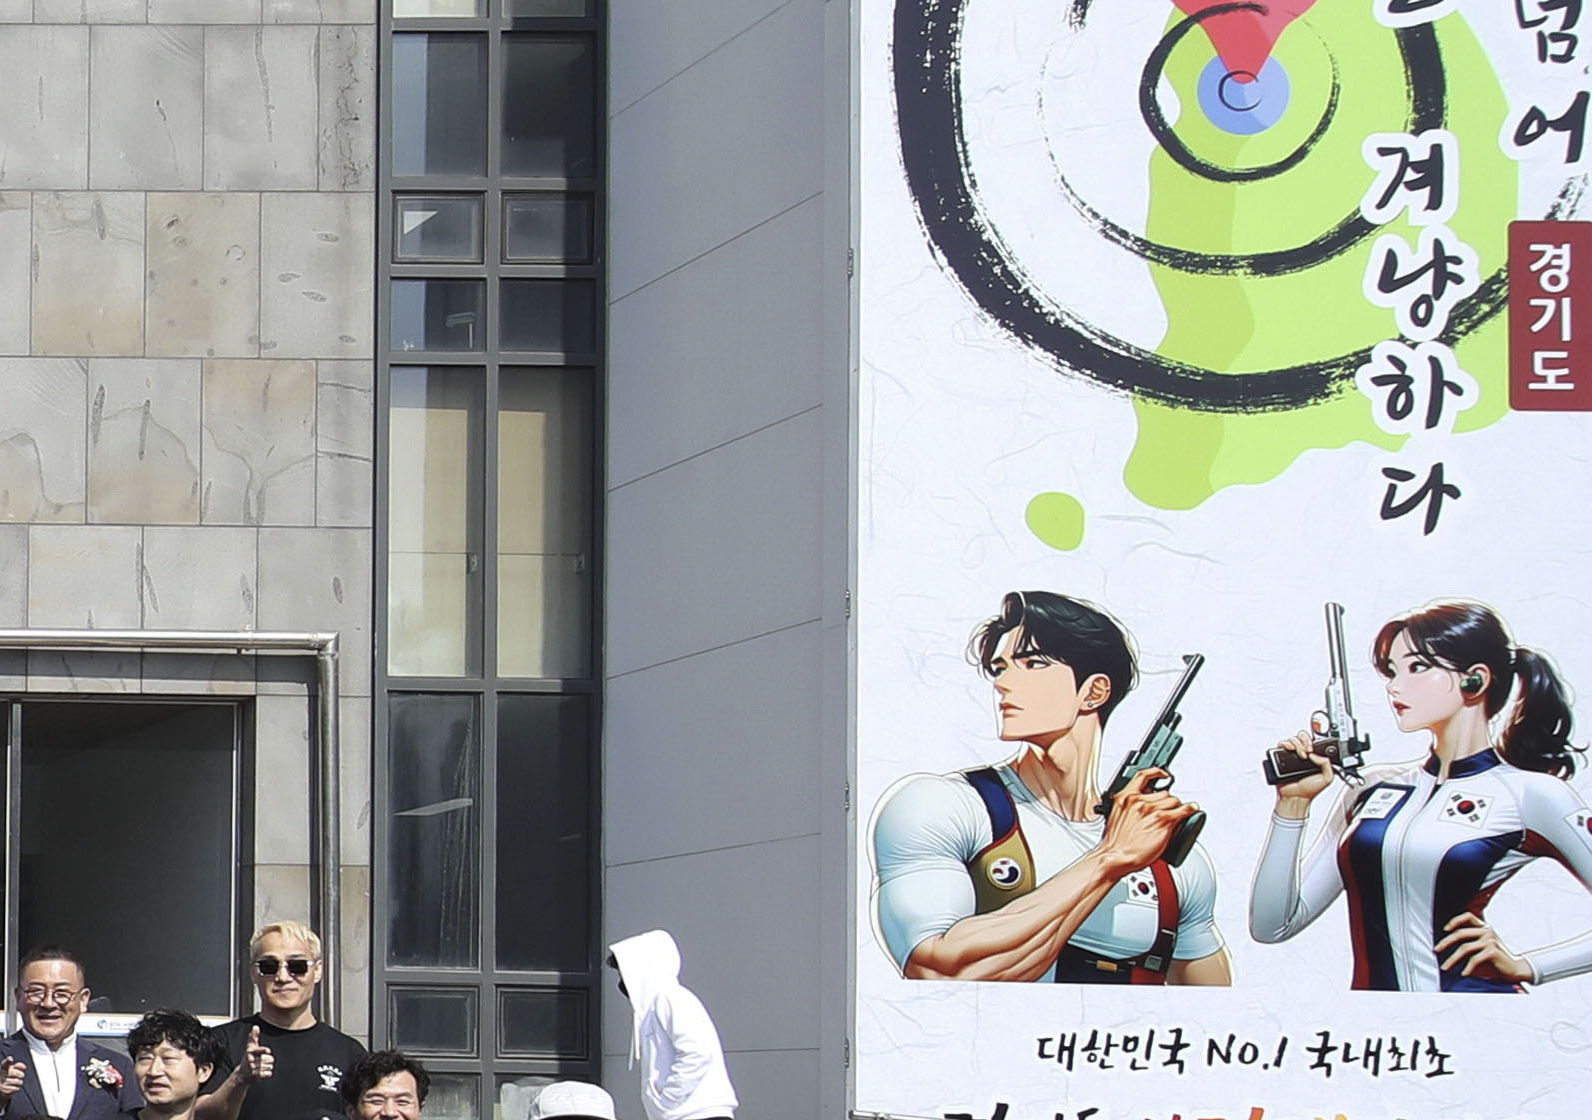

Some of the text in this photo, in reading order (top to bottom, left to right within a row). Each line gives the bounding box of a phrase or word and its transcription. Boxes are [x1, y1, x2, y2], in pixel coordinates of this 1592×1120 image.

[1369, 142, 1465, 536] 겨냥하다
[1527, 242, 1576, 391] 경기도
[1037, 1027, 1191, 1075] 대한민국
[1305, 1030, 1455, 1078] 국내최초
